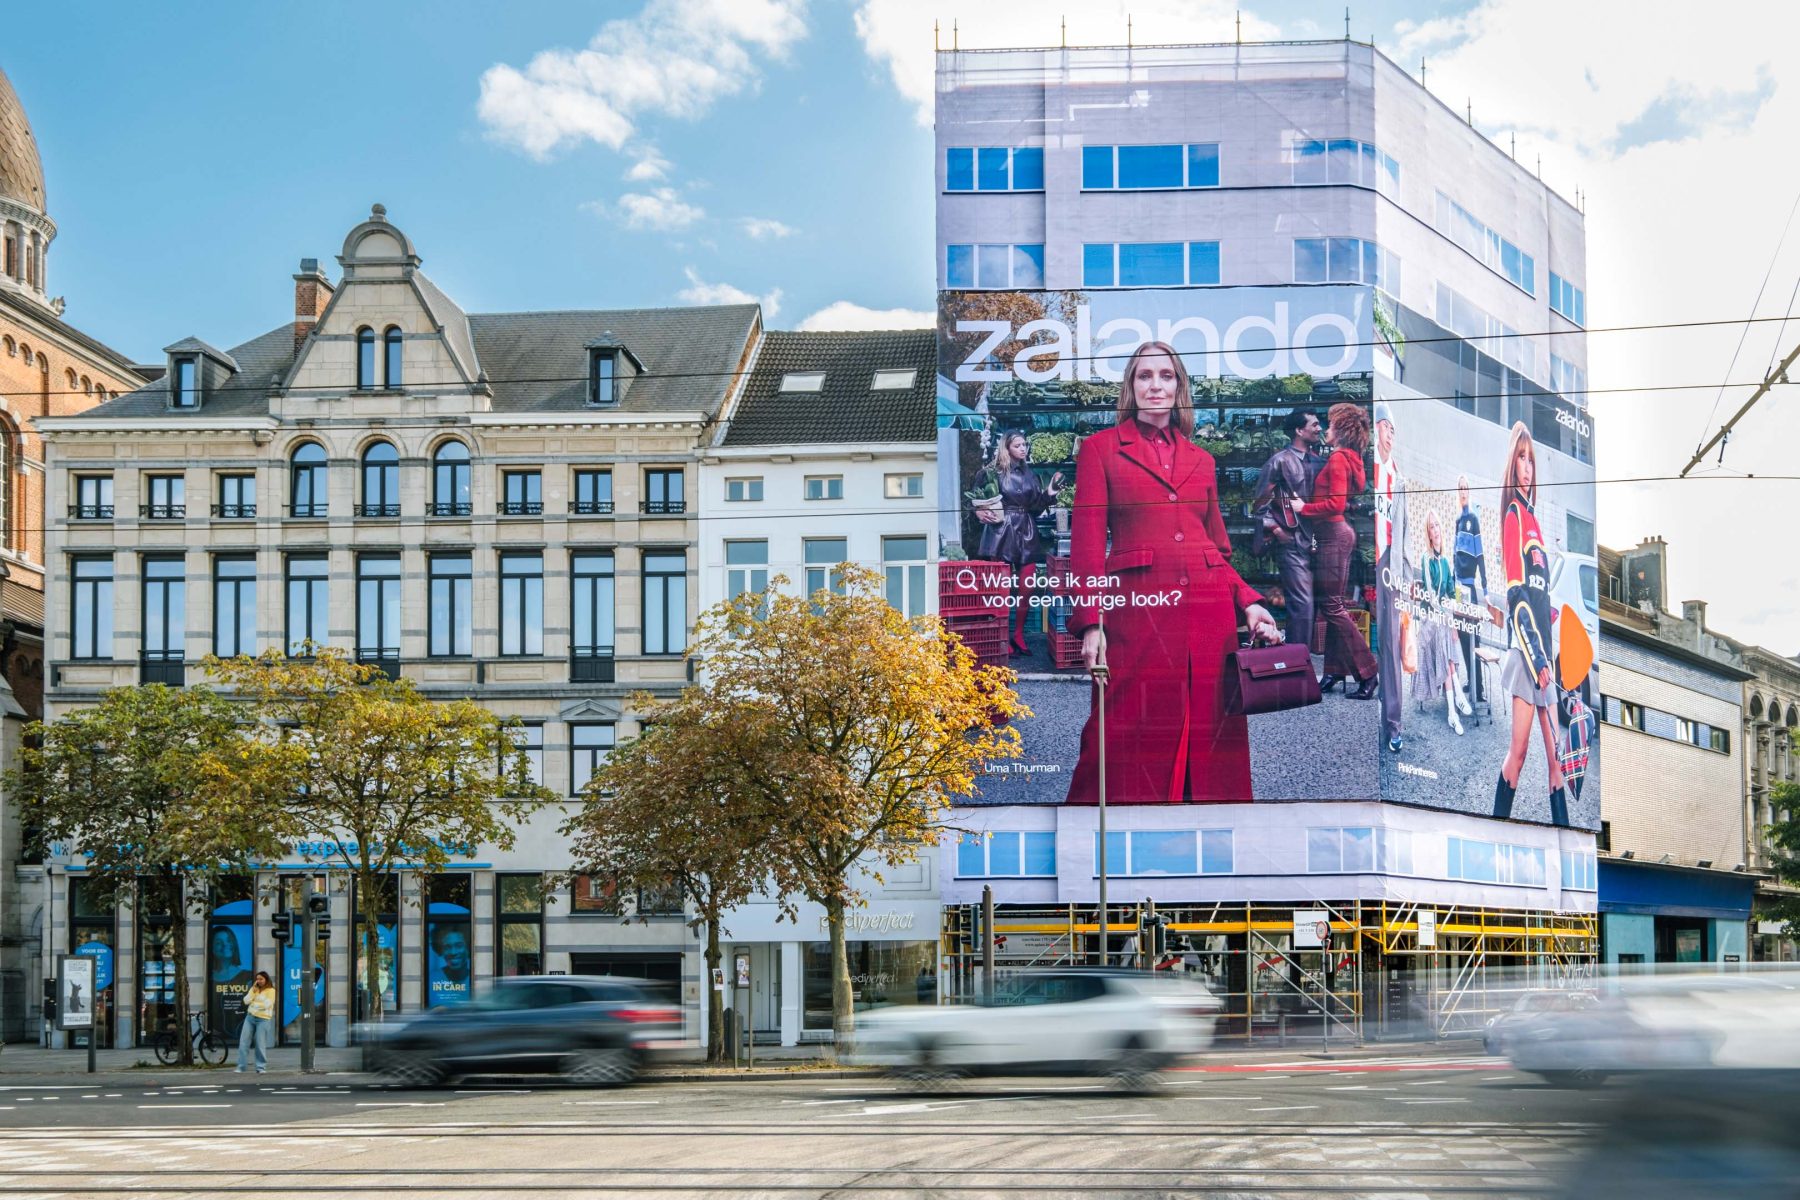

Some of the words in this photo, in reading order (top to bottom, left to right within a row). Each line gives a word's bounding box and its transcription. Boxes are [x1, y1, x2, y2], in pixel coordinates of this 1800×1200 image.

[956, 301, 1359, 382] zalando
[1555, 407, 1590, 438] zalando
[982, 572, 1019, 588] Wat
[1024, 573, 1060, 588] doe
[1065, 572, 1081, 588] ik
[1086, 574, 1121, 588] aan
[982, 594, 1023, 608] voor
[1028, 594, 1064, 608] een
[1069, 591, 1126, 610] vurige
[1131, 590, 1182, 607] look?
[1394, 574, 1413, 596] Wat
[1413, 583, 1430, 602] doe
[1441, 596, 1456, 611] aan
[1394, 598, 1411, 613] aan
[1413, 604, 1427, 618] me
[1428, 606, 1447, 627] blijft
[1448, 612, 1482, 636] denken?
[984, 762, 1010, 773] Uma
[1012, 762, 1060, 773] Thurman
[819, 906, 914, 934] pdiperfect
[216, 984, 228, 993] BE
[230, 984, 249, 993] YOU
[432, 984, 442, 992] IN
[444, 984, 466, 992] CARE
